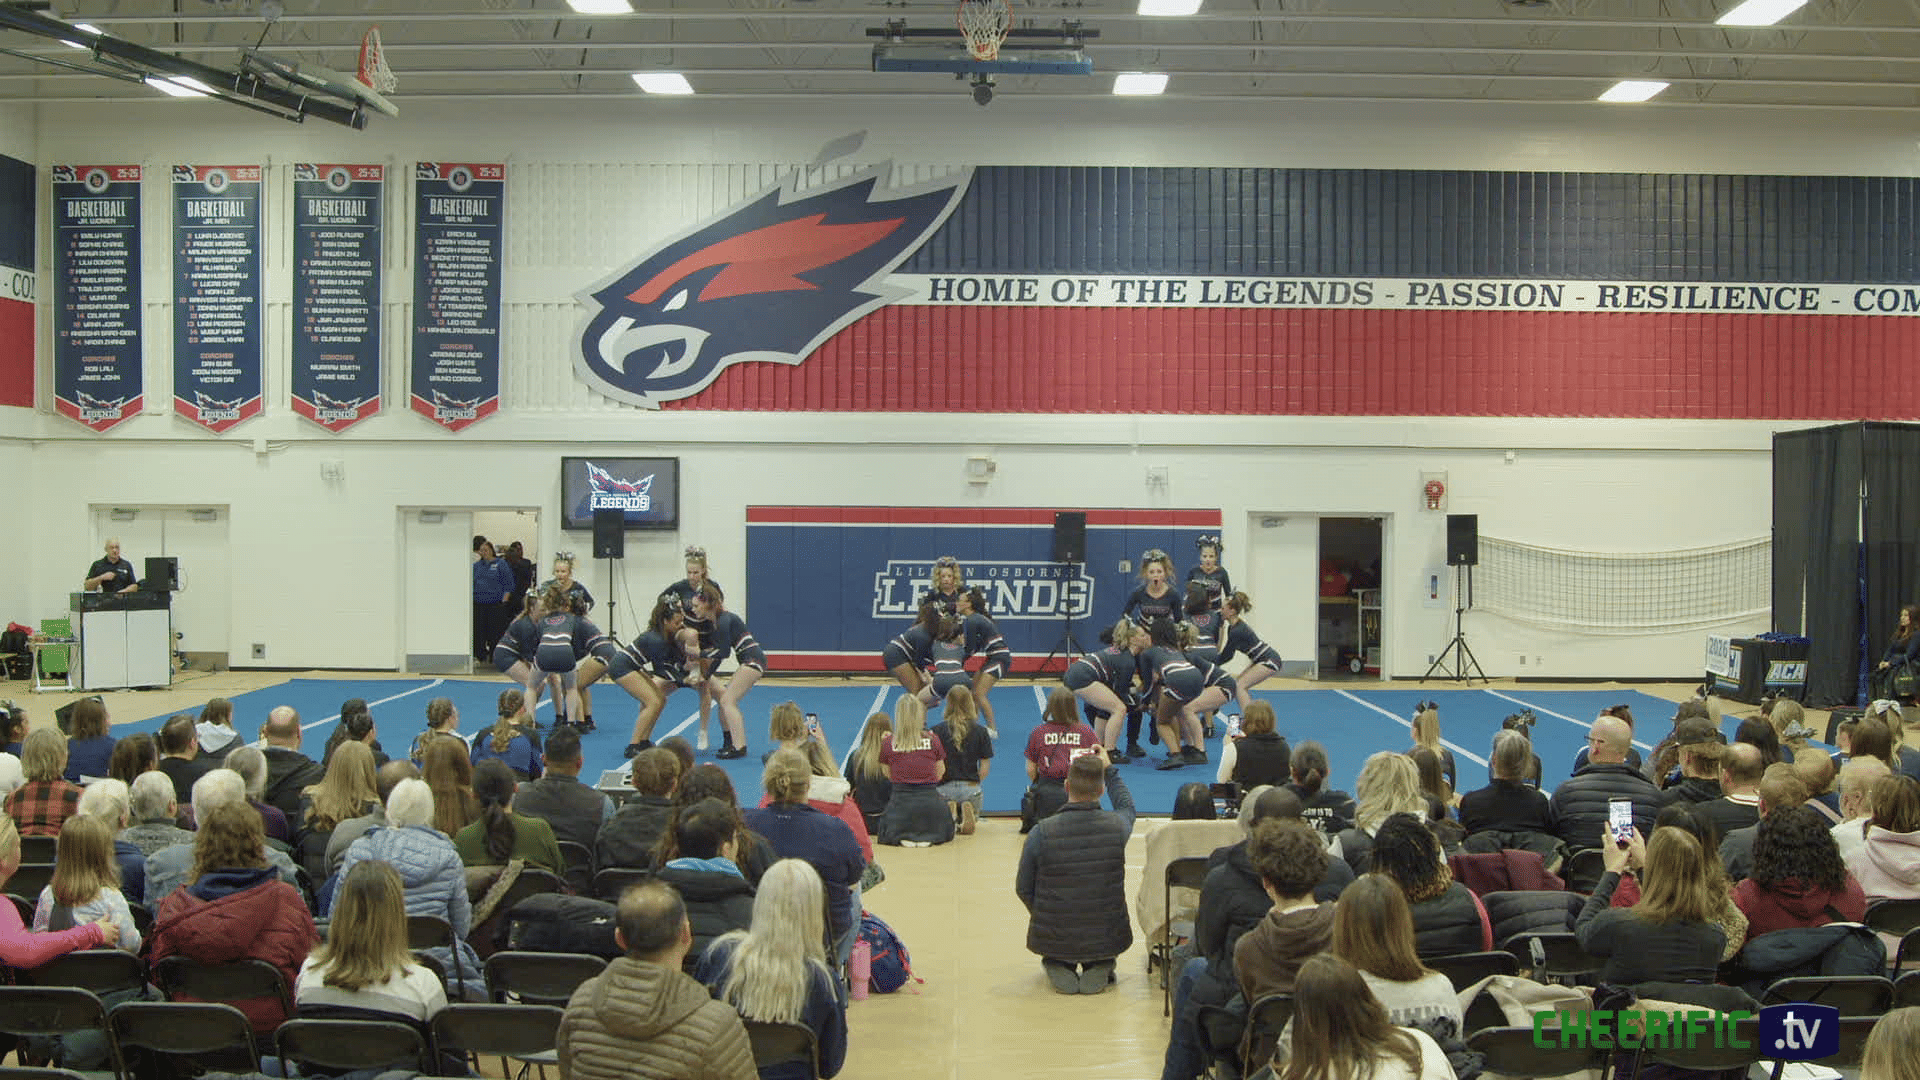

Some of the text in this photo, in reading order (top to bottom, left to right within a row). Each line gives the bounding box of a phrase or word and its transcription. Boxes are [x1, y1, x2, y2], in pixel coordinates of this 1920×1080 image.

[68, 201, 126, 217] BASKETBALL
[187, 201, 245, 217] BASKETBALL
[309, 200, 367, 216] BASKETBALL
[430, 199, 488, 216] BASKETBALL
[12, 273, 35, 299] CO
[928, 278, 1038, 302] HOME
[1050, 279, 1099, 302] OF
[1111, 280, 1187, 303] THE
[1199, 280, 1374, 305] LEGENDS
[1407, 282, 1565, 308] PASSION
[1596, 285, 1820, 310] RESILIENCE
[593, 497, 647, 508] LEGENDS
[896, 567, 974, 577] LILN
[880, 579, 1088, 613] LENDS
[892, 738, 931, 751] CCH
[1045, 733, 1080, 745] COACH
